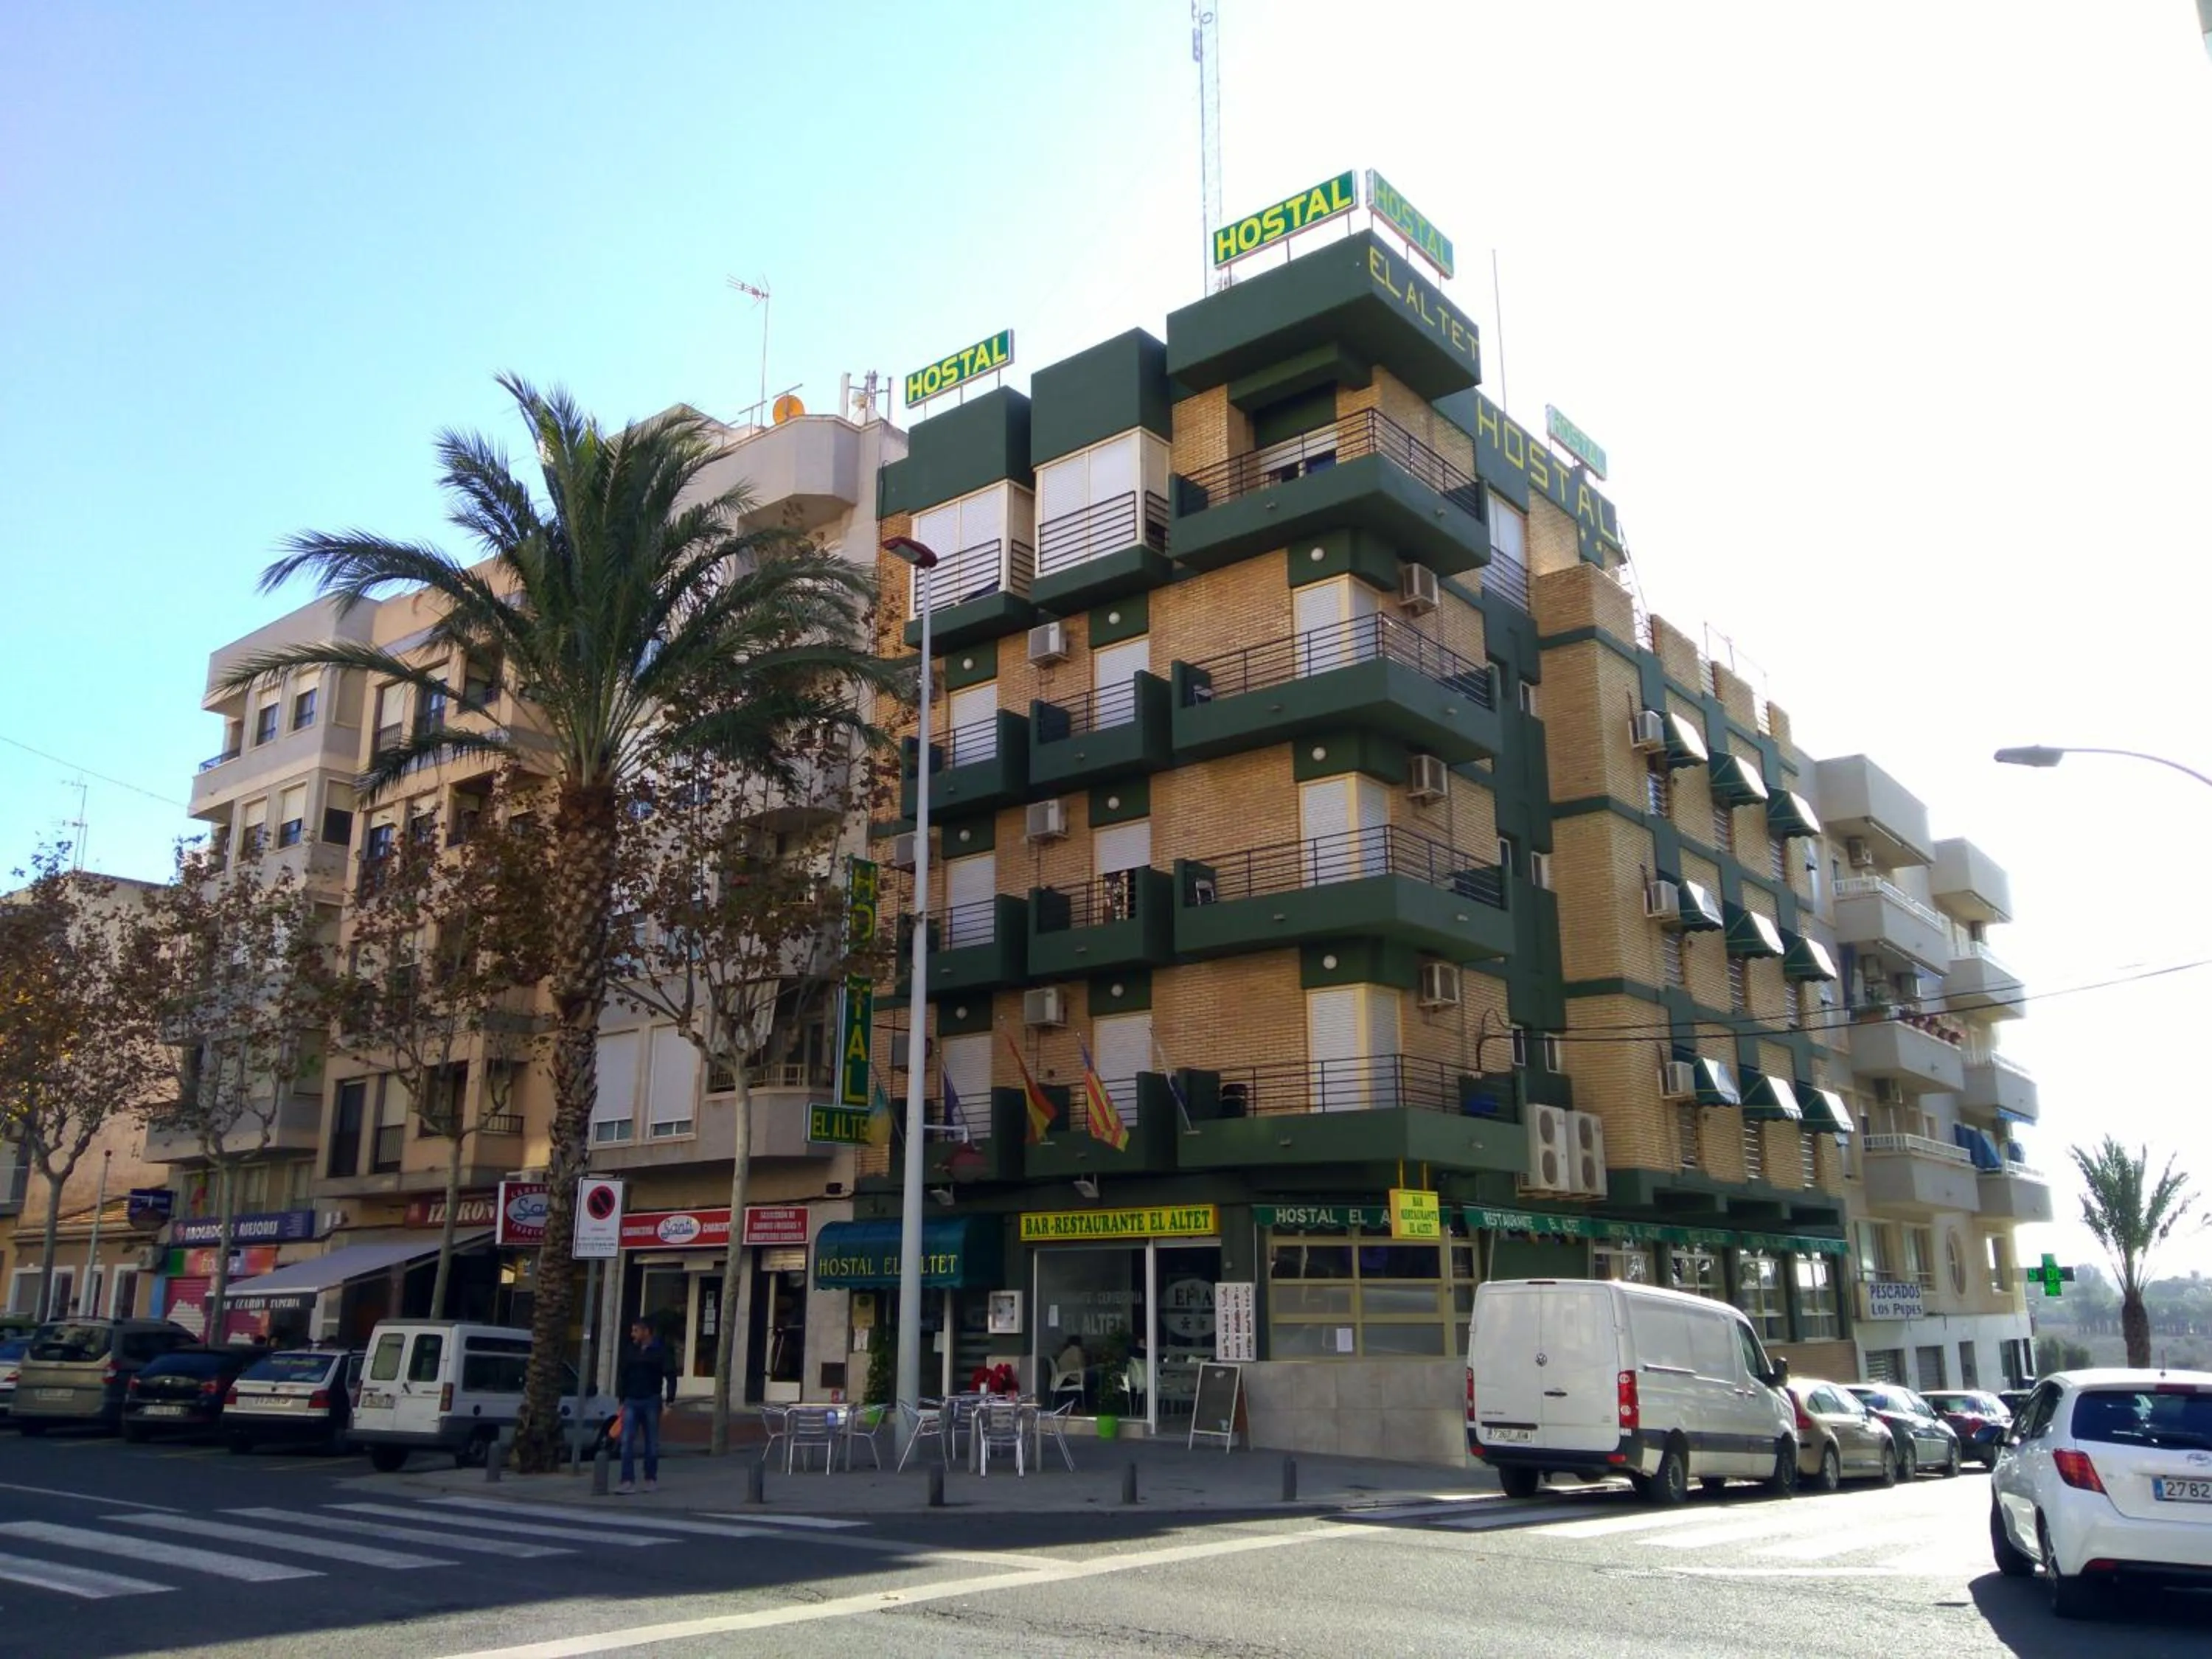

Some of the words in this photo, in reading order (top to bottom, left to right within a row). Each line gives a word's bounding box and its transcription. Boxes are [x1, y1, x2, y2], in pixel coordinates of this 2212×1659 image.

[1217, 178, 1352, 262] HOSTAL
[1374, 173, 1453, 267] HOSTAL
[1369, 245, 1402, 299] EL
[1406, 283, 1479, 361] ALTET
[908, 337, 1006, 403] HOSTAL
[1478, 396, 1618, 543] HOSTAL
[844, 865, 875, 1103] HOTAL
[813, 1111, 830, 1136] EL
[832, 1112, 872, 1141] ALTE
[1150, 1213, 1165, 1230] EL
[1169, 1210, 1210, 1230] ALTET
[1276, 1208, 1338, 1225] HOSTAL
[1349, 1208, 1368, 1225] EL
[818, 1258, 875, 1276] HOSTAL
[884, 1257, 902, 1276] EL
[919, 1254, 958, 1274] LTET
[1869, 1284, 1921, 1298] PESCADOS
[2165, 1480, 2211, 1498] 2782
